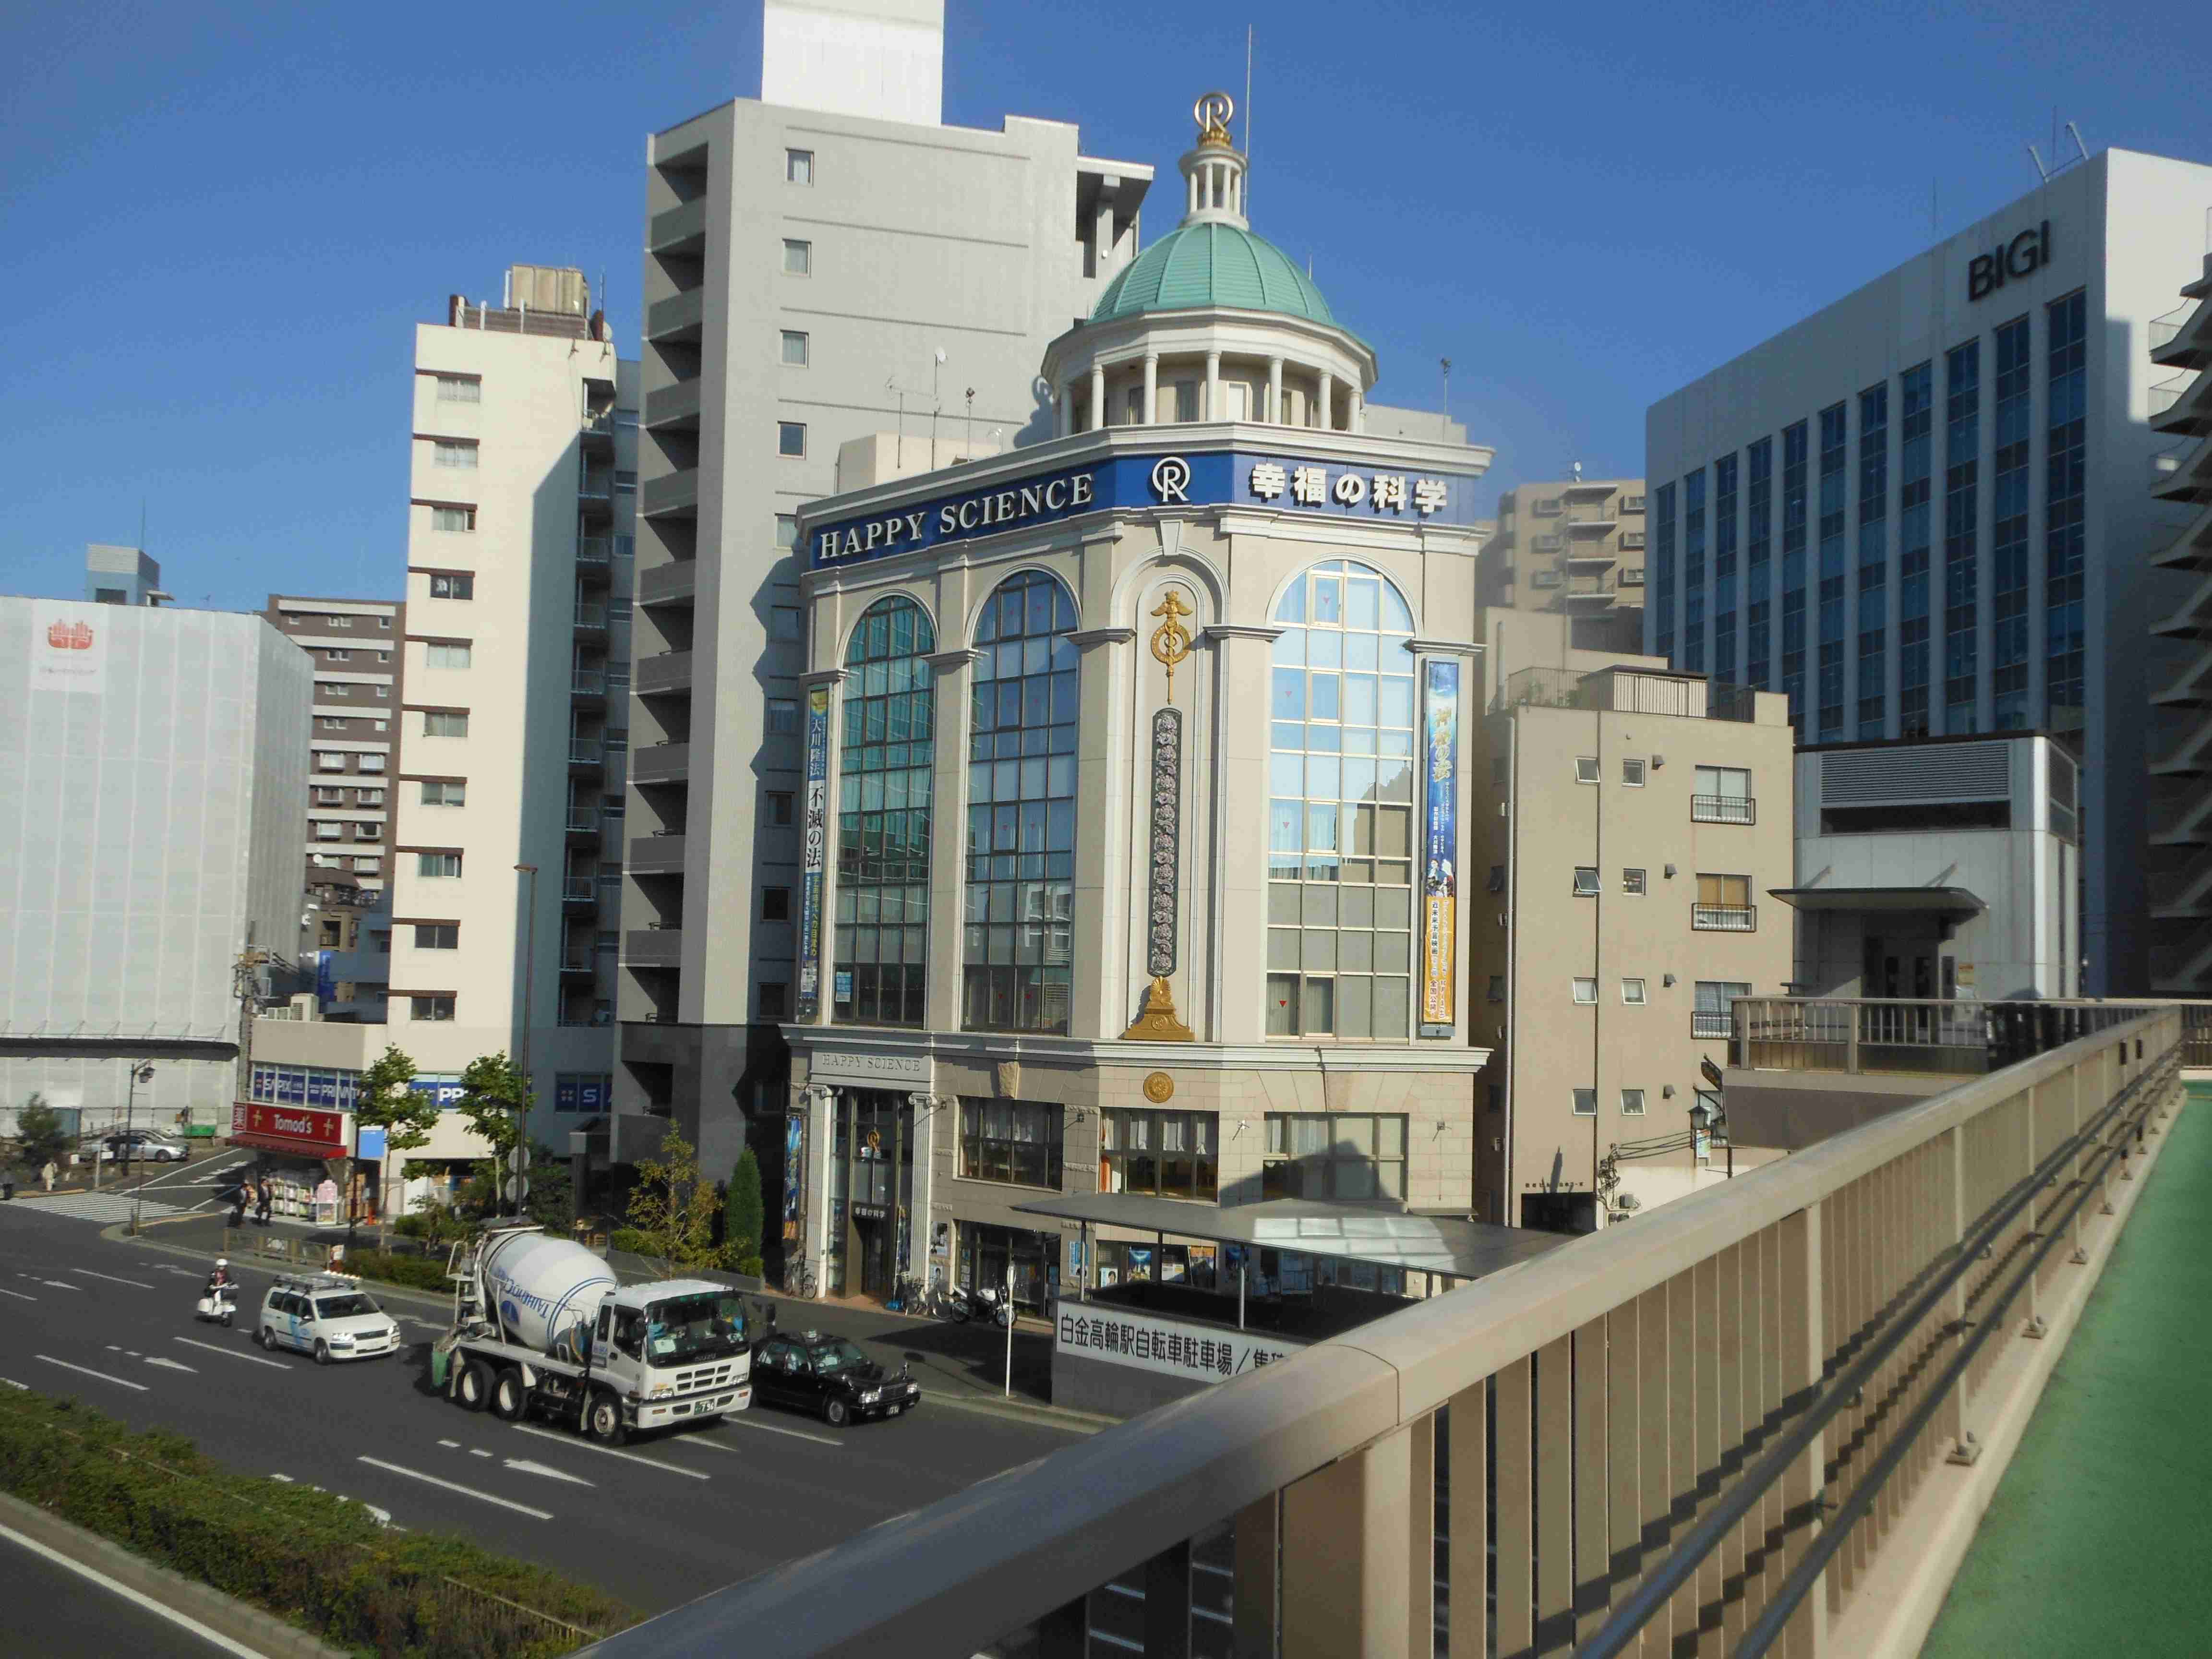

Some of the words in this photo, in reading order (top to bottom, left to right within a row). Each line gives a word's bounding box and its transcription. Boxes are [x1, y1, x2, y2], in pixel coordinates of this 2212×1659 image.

[1968, 219, 2050, 302] BIGI
[819, 511, 926, 560] HAPPY
[939, 473, 1094, 535] SCIENCE
[1251, 462, 1449, 515] 幸福の科学
[810, 719, 822, 776] 大川隆法
[806, 786, 823, 868] 不滅の法
[822, 1054, 863, 1067] HAPPY
[867, 1057, 921, 1072] SCIENCE
[273, 1113, 313, 1134] Tomod's
